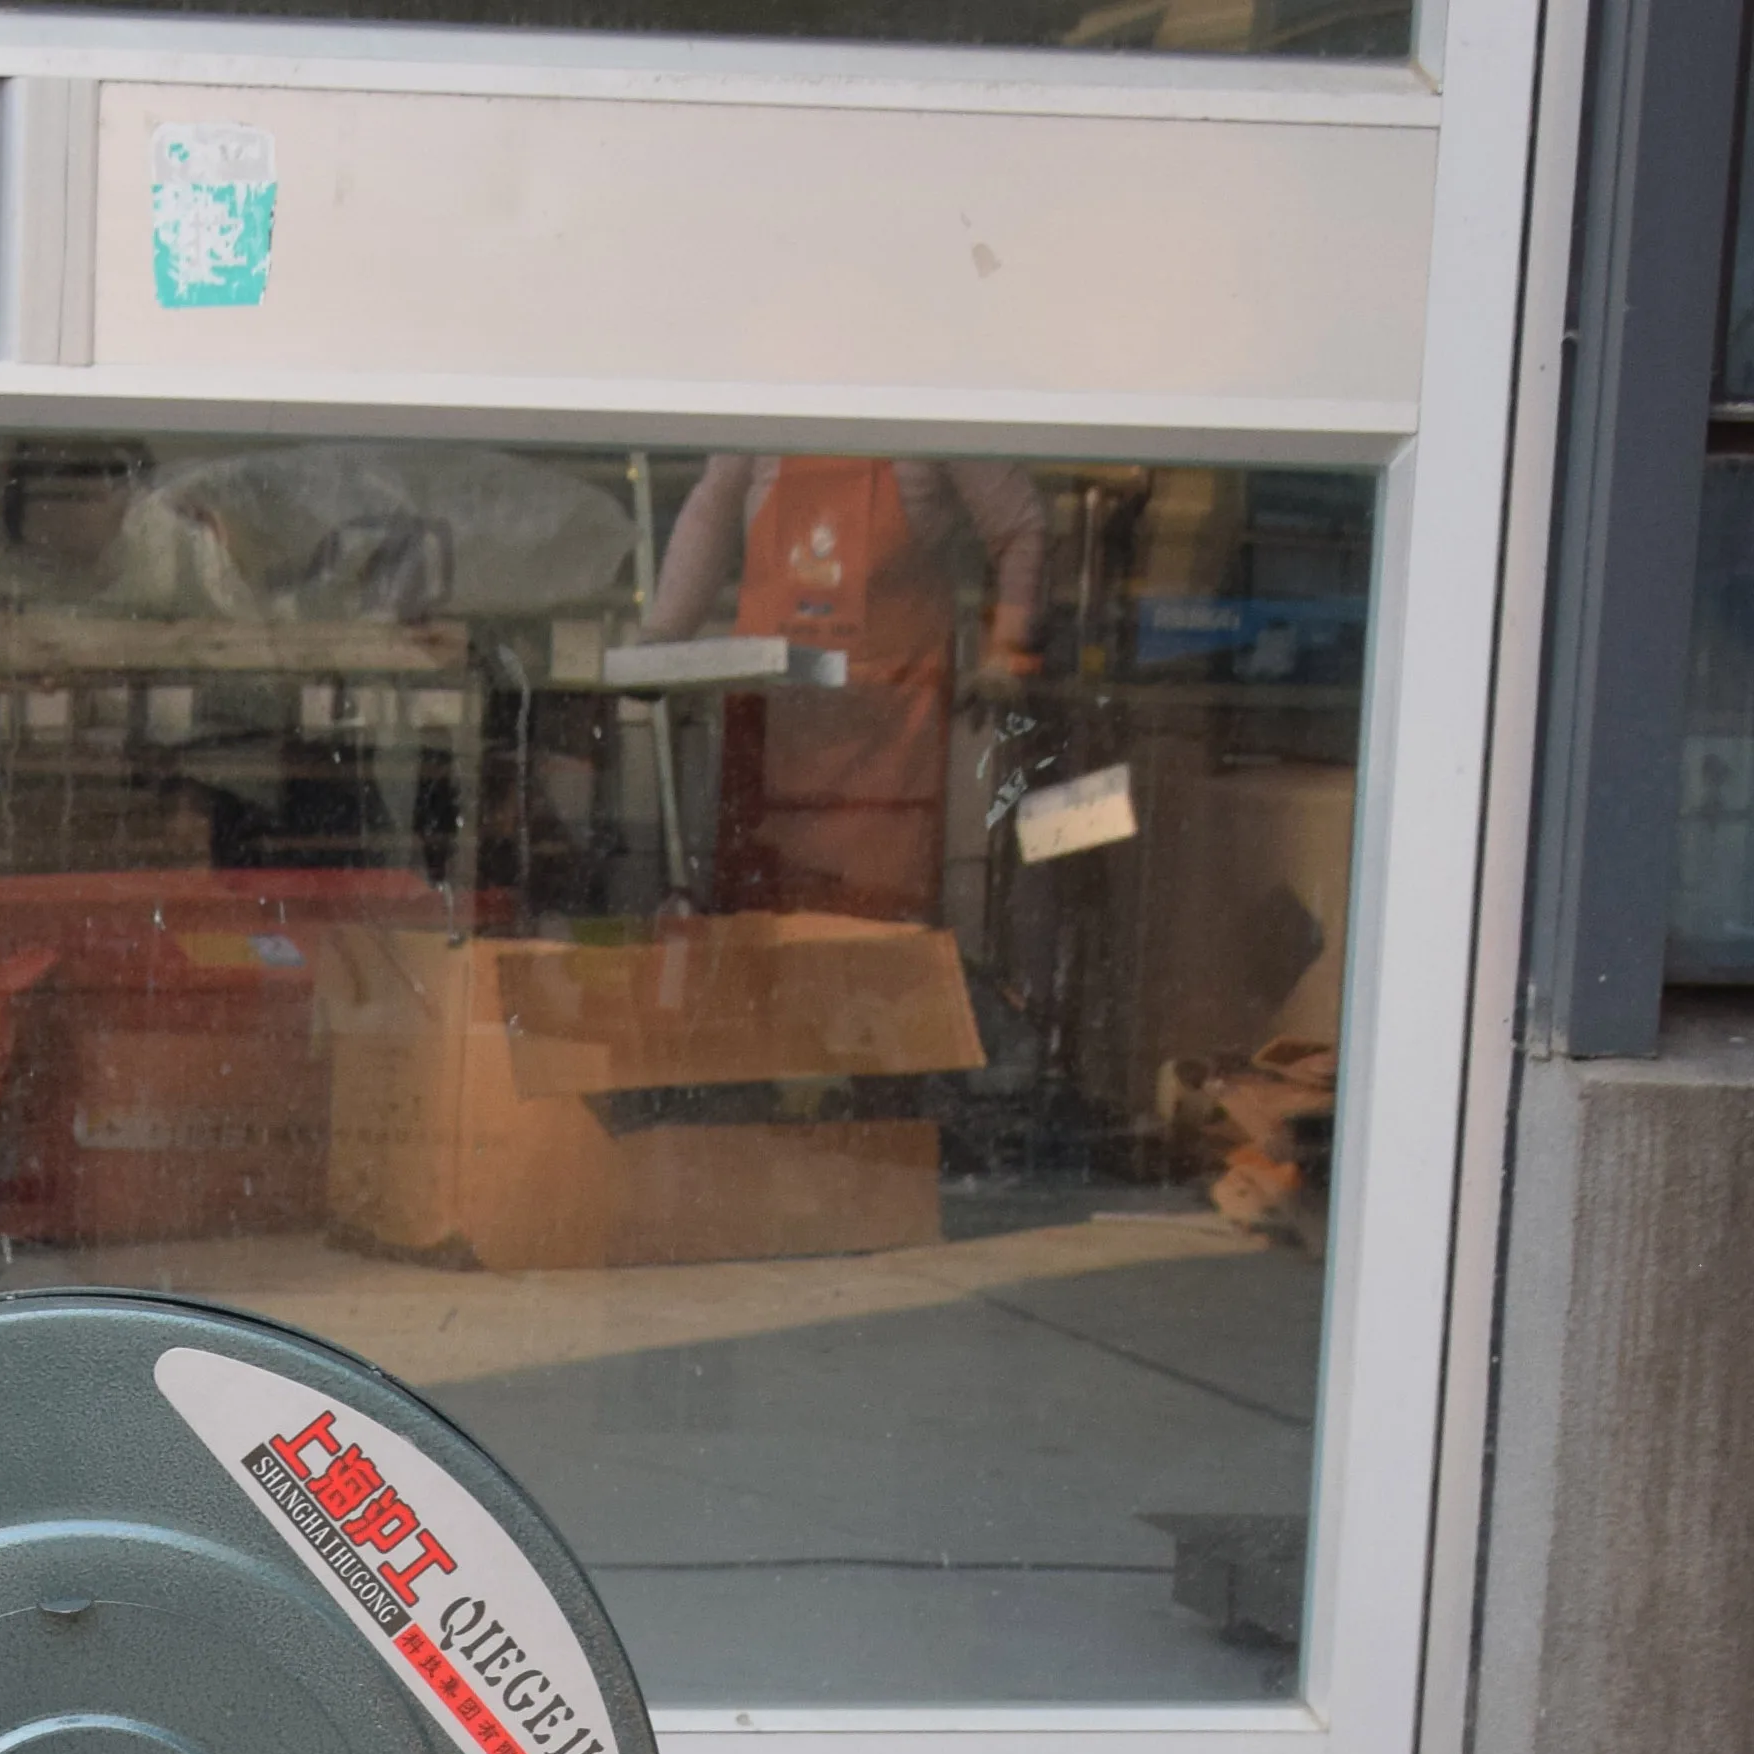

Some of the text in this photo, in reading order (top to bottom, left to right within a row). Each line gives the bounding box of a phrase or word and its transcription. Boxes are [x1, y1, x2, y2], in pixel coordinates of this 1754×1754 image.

[253, 1456, 399, 1624] SHANGHAIHUGONG
[269, 1410, 457, 1606] 上海沪工
